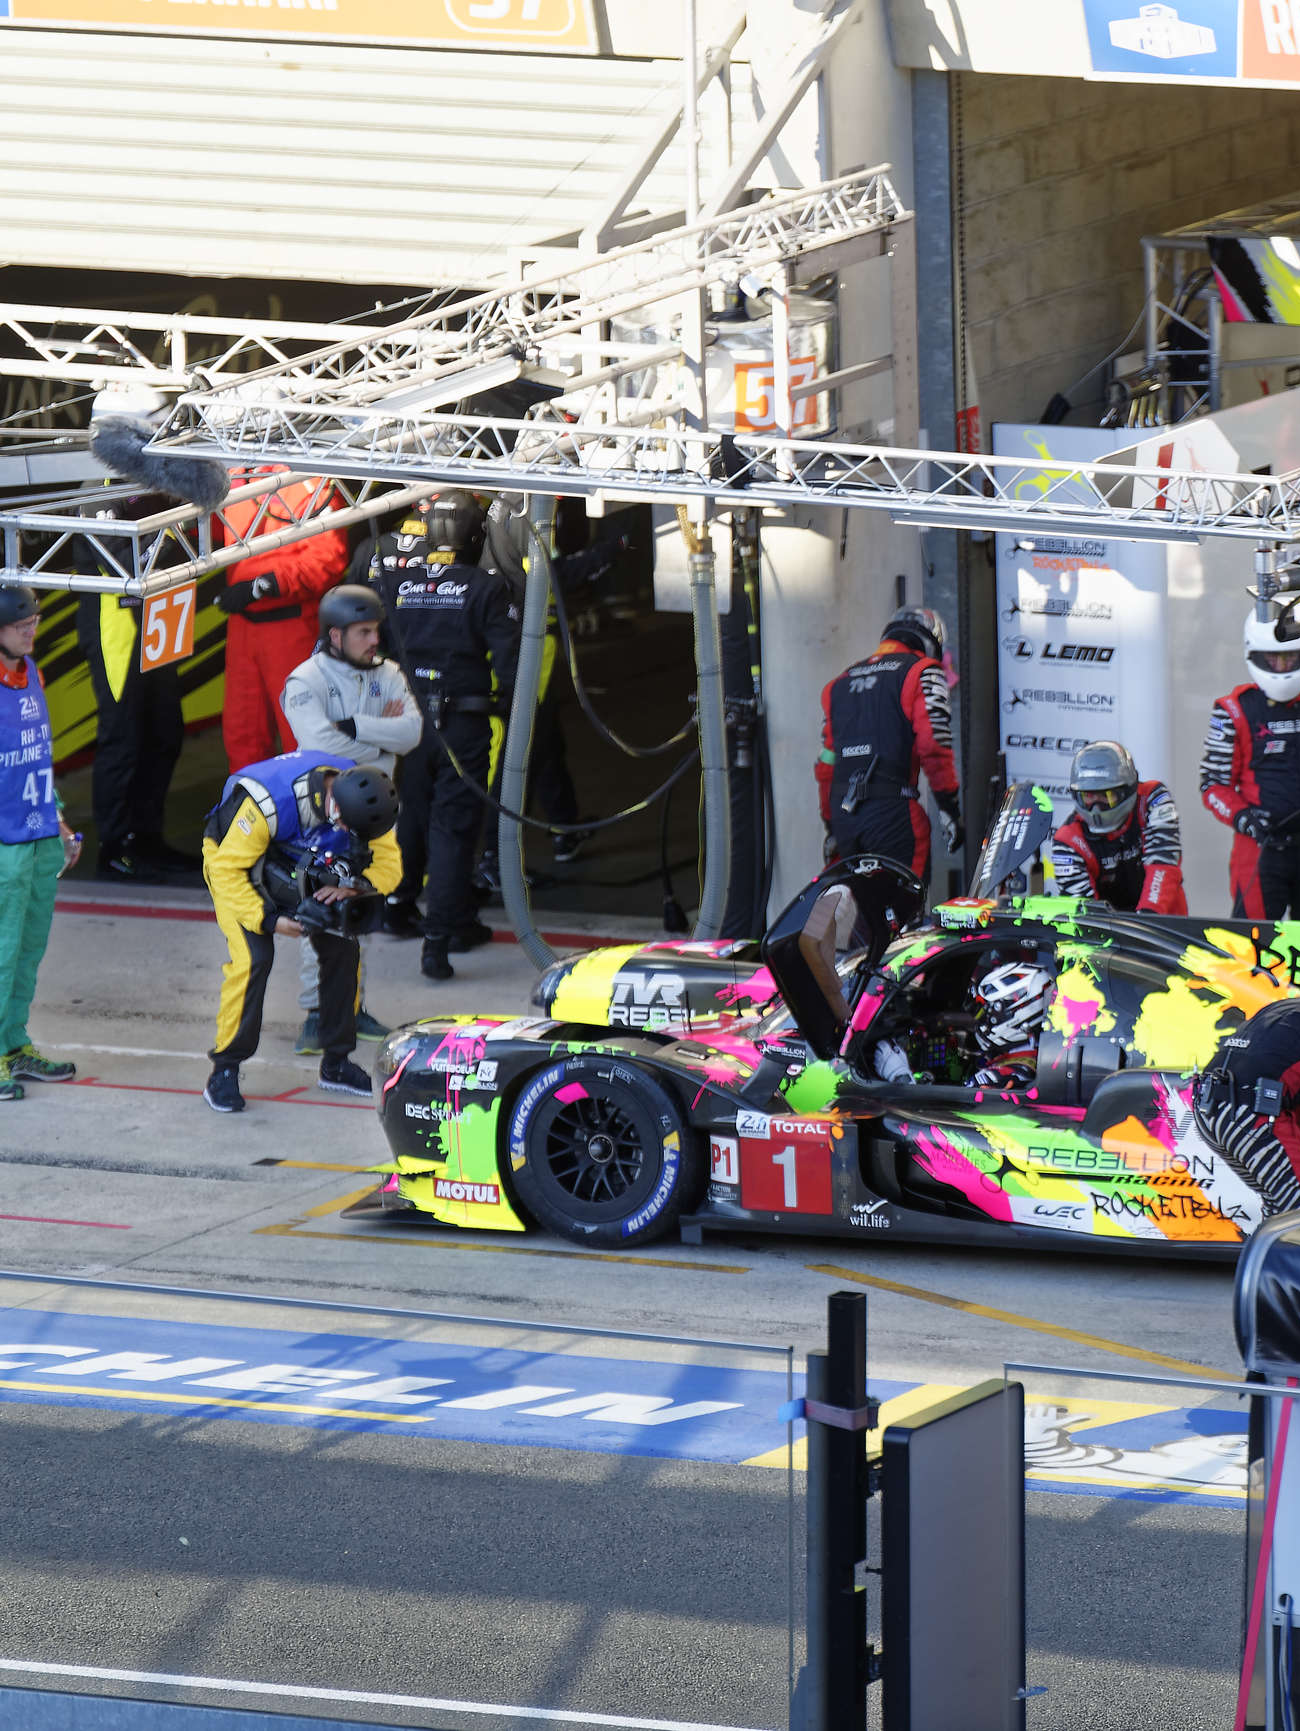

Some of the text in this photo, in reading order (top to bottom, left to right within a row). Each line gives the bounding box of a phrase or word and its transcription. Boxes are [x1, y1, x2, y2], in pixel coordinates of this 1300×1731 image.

[145, 589, 194, 663] 57
[1040, 643, 1116, 663] LEMO
[1022, 688, 1114, 706] REBELLION
[22, 767, 53, 806] 47
[611, 971, 686, 1005] TVR
[405, 1103, 431, 1120] IDEC
[512, 1068, 560, 1138] MICHELIN
[772, 1119, 828, 1135] TOTAL
[1027, 1146, 1215, 1176] REBELLION
[711, 1143, 798, 1208] P1 1
[435, 1180, 498, 1203] MOTUL
[627, 1164, 677, 1233] MICHELIN
[850, 1214, 891, 1229] wil.life
[1033, 1204, 1086, 1220] WEC
